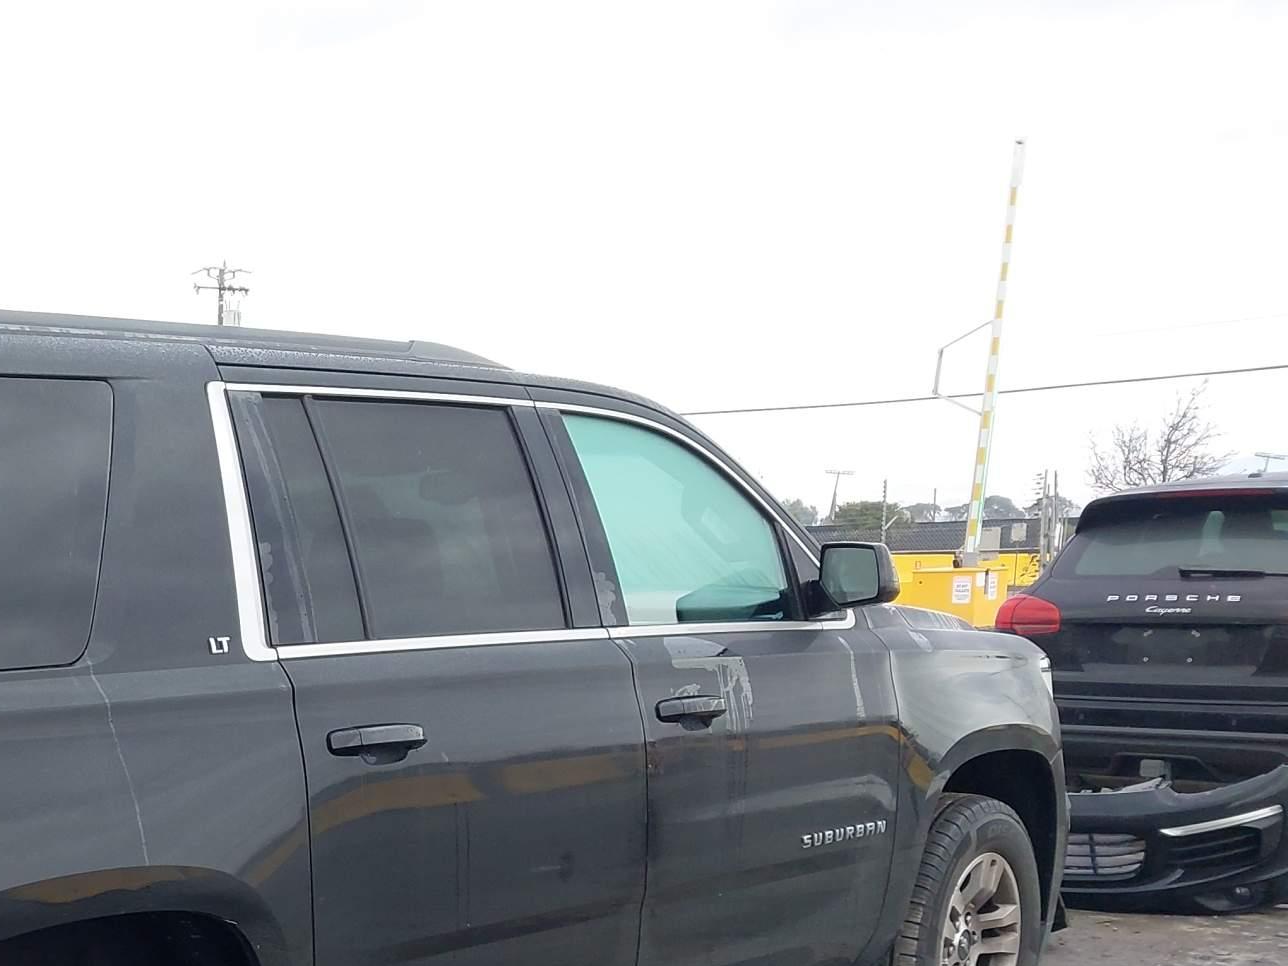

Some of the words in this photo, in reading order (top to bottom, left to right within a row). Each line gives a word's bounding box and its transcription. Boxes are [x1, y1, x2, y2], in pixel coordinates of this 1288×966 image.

[1107, 594, 1241, 602] PORSCHE
[1145, 605, 1192, 616] Cayenne
[208, 636, 231, 654] LT
[802, 819, 887, 849] SUBURBAN
